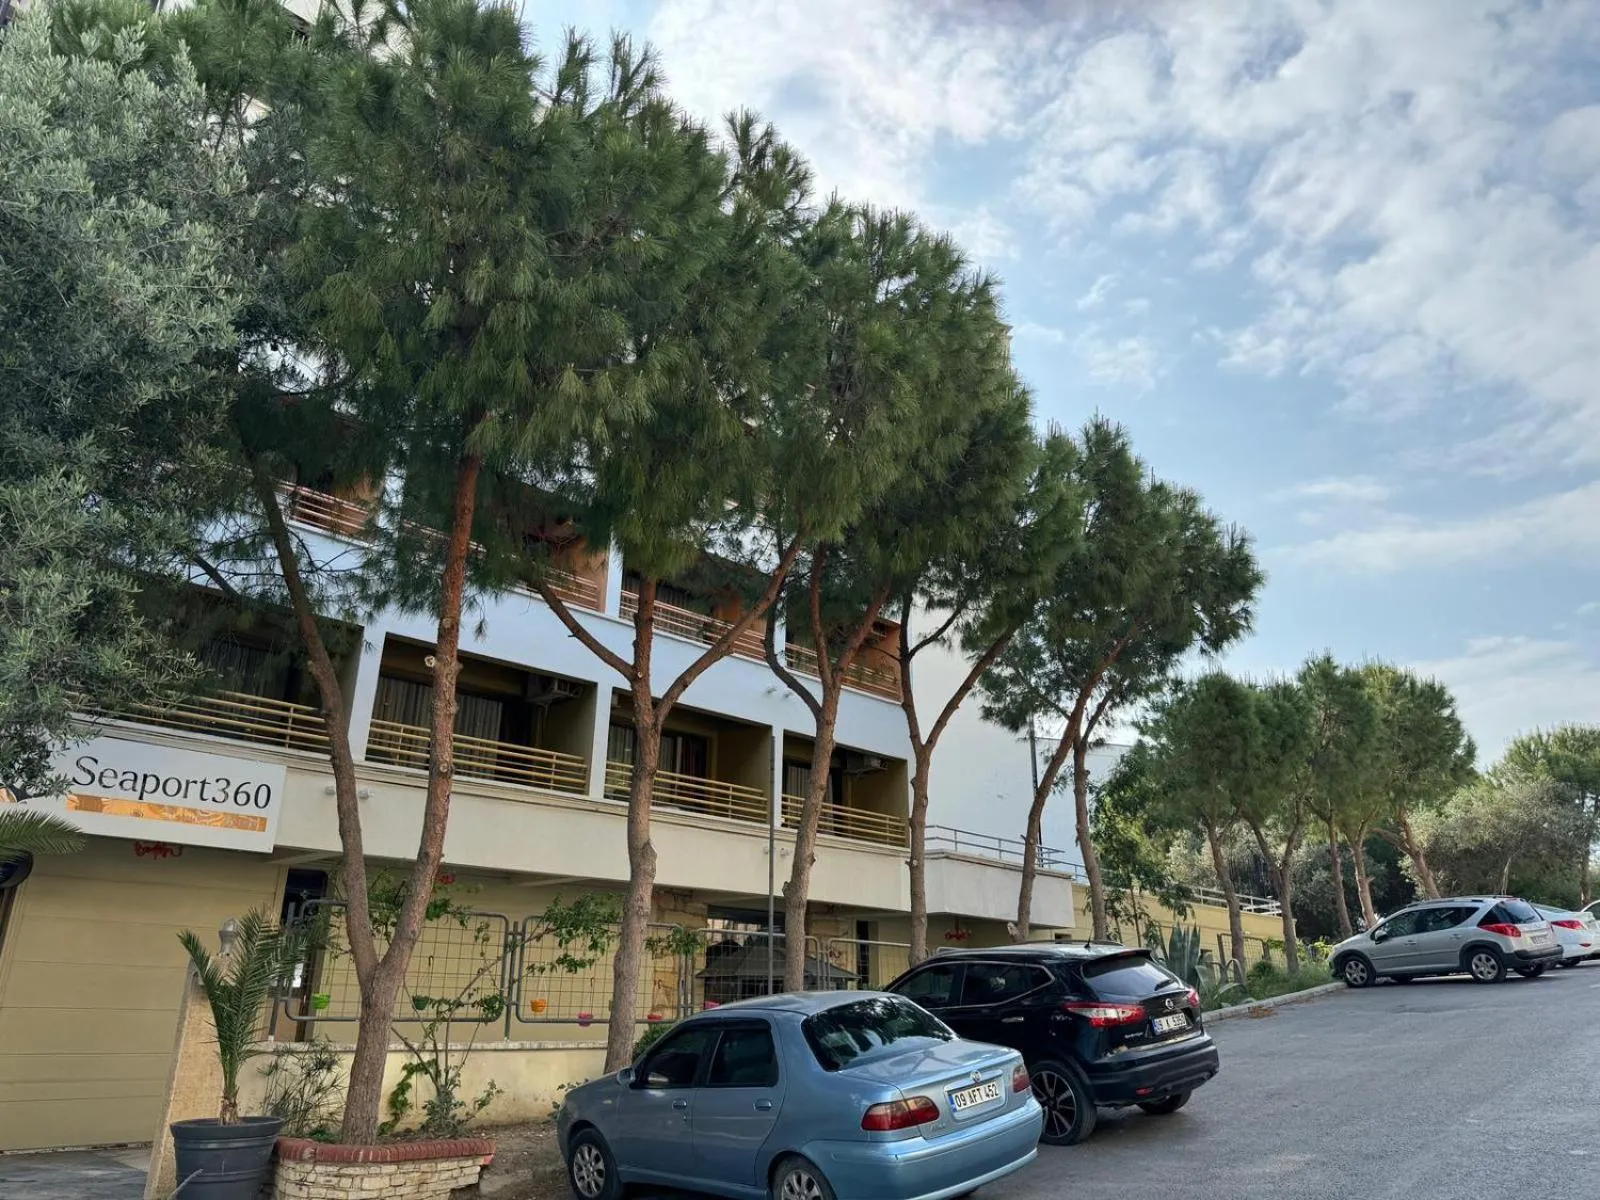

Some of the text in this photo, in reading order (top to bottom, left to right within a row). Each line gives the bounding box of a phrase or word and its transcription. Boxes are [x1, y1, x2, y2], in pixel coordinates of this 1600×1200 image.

[72, 756, 271, 809] Seaport360
[954, 1093, 967, 1107] 09
[968, 1087, 983, 1104] AFT
